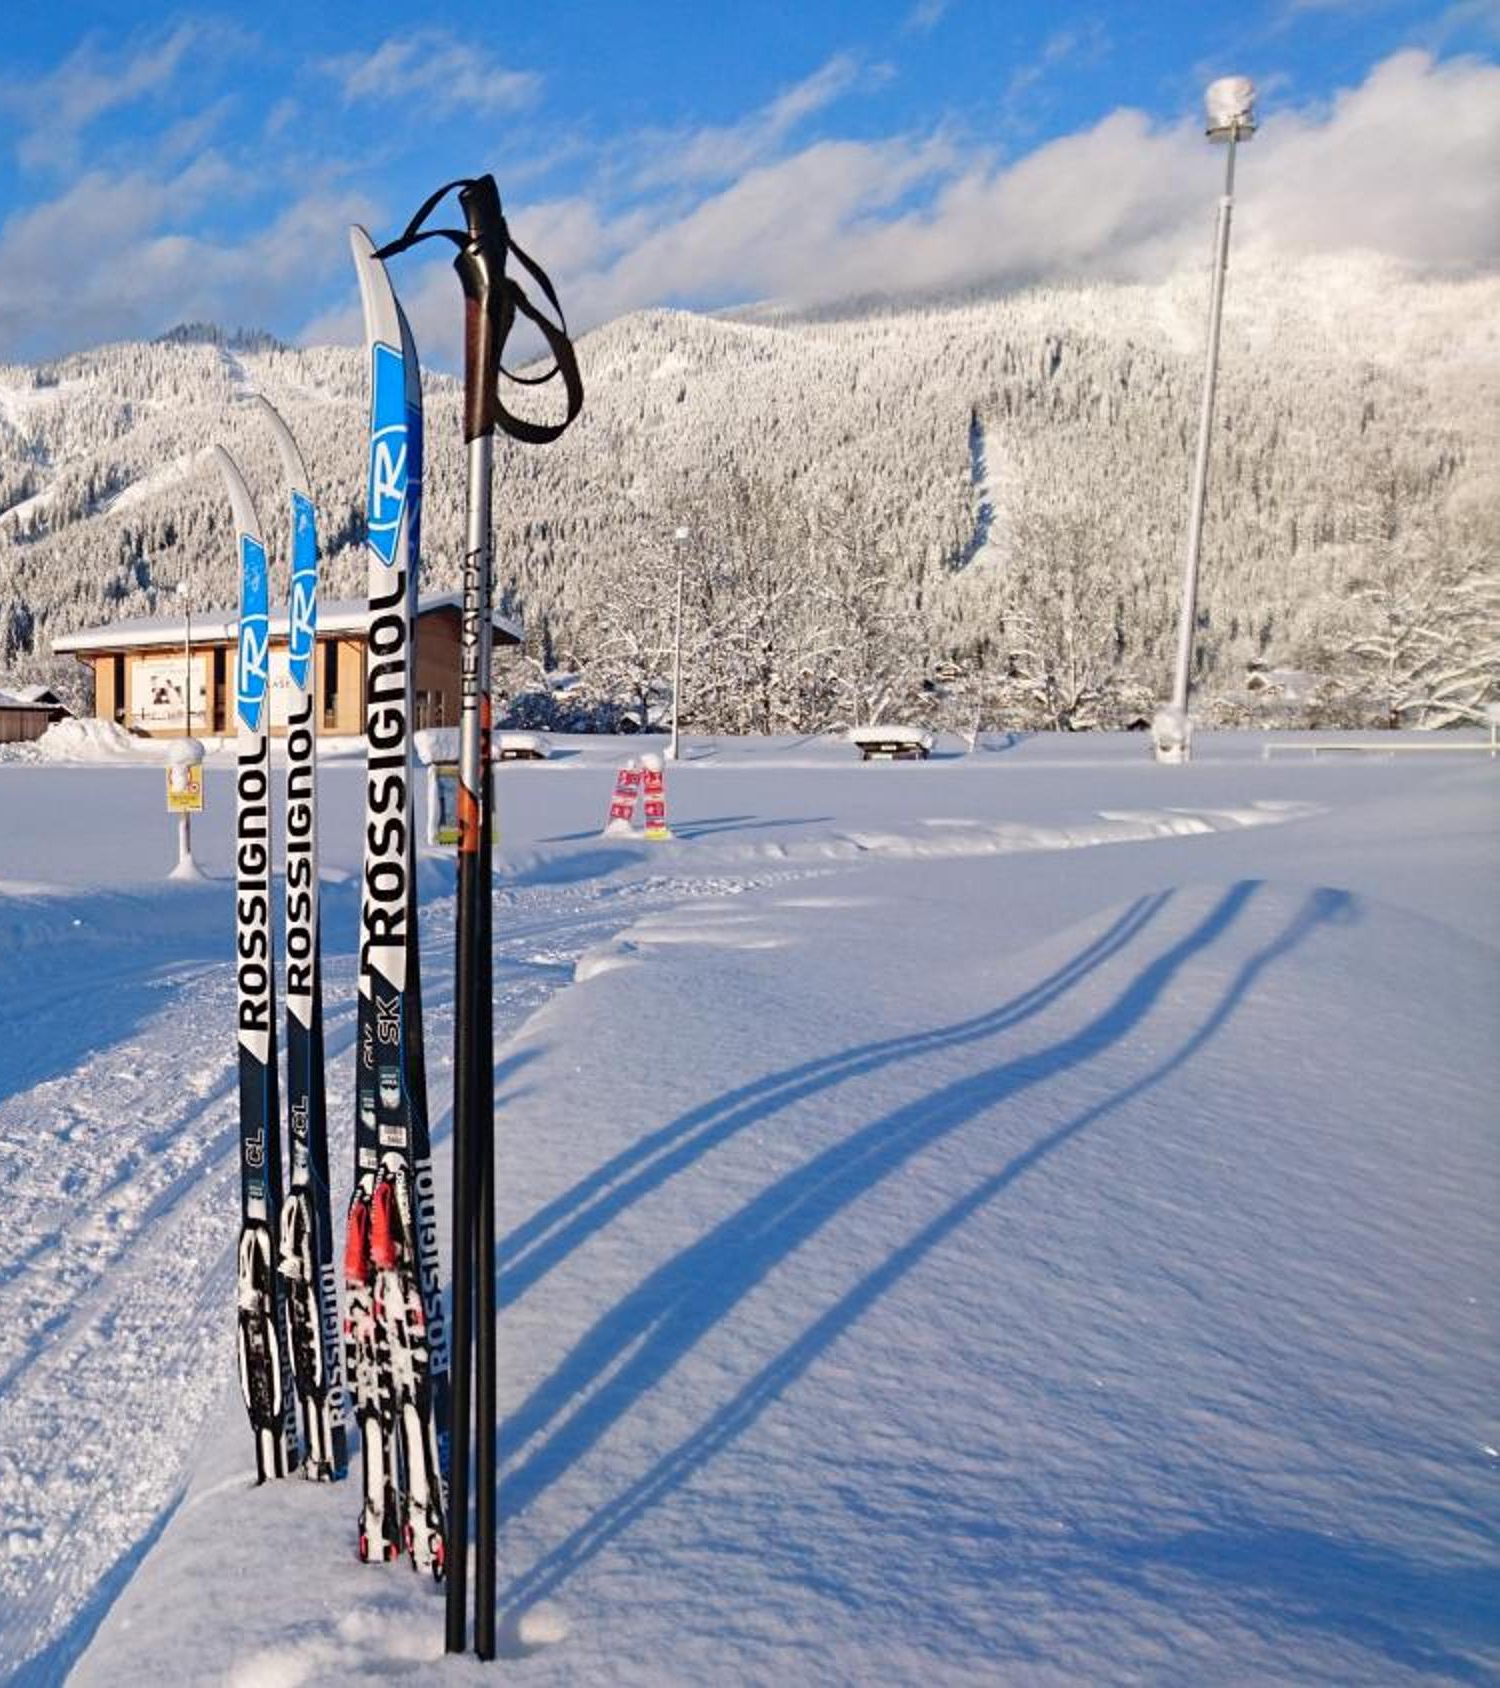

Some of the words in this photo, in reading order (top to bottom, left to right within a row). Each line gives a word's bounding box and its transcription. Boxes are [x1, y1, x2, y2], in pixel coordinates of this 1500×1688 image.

[238, 736, 268, 1031] ROSSIGNOL
[287, 694, 312, 996] ROSSIGNOL
[367, 571, 406, 947] ROSSIGNOL
[245, 1127, 265, 1169] CL
[375, 995, 401, 1046] SK
